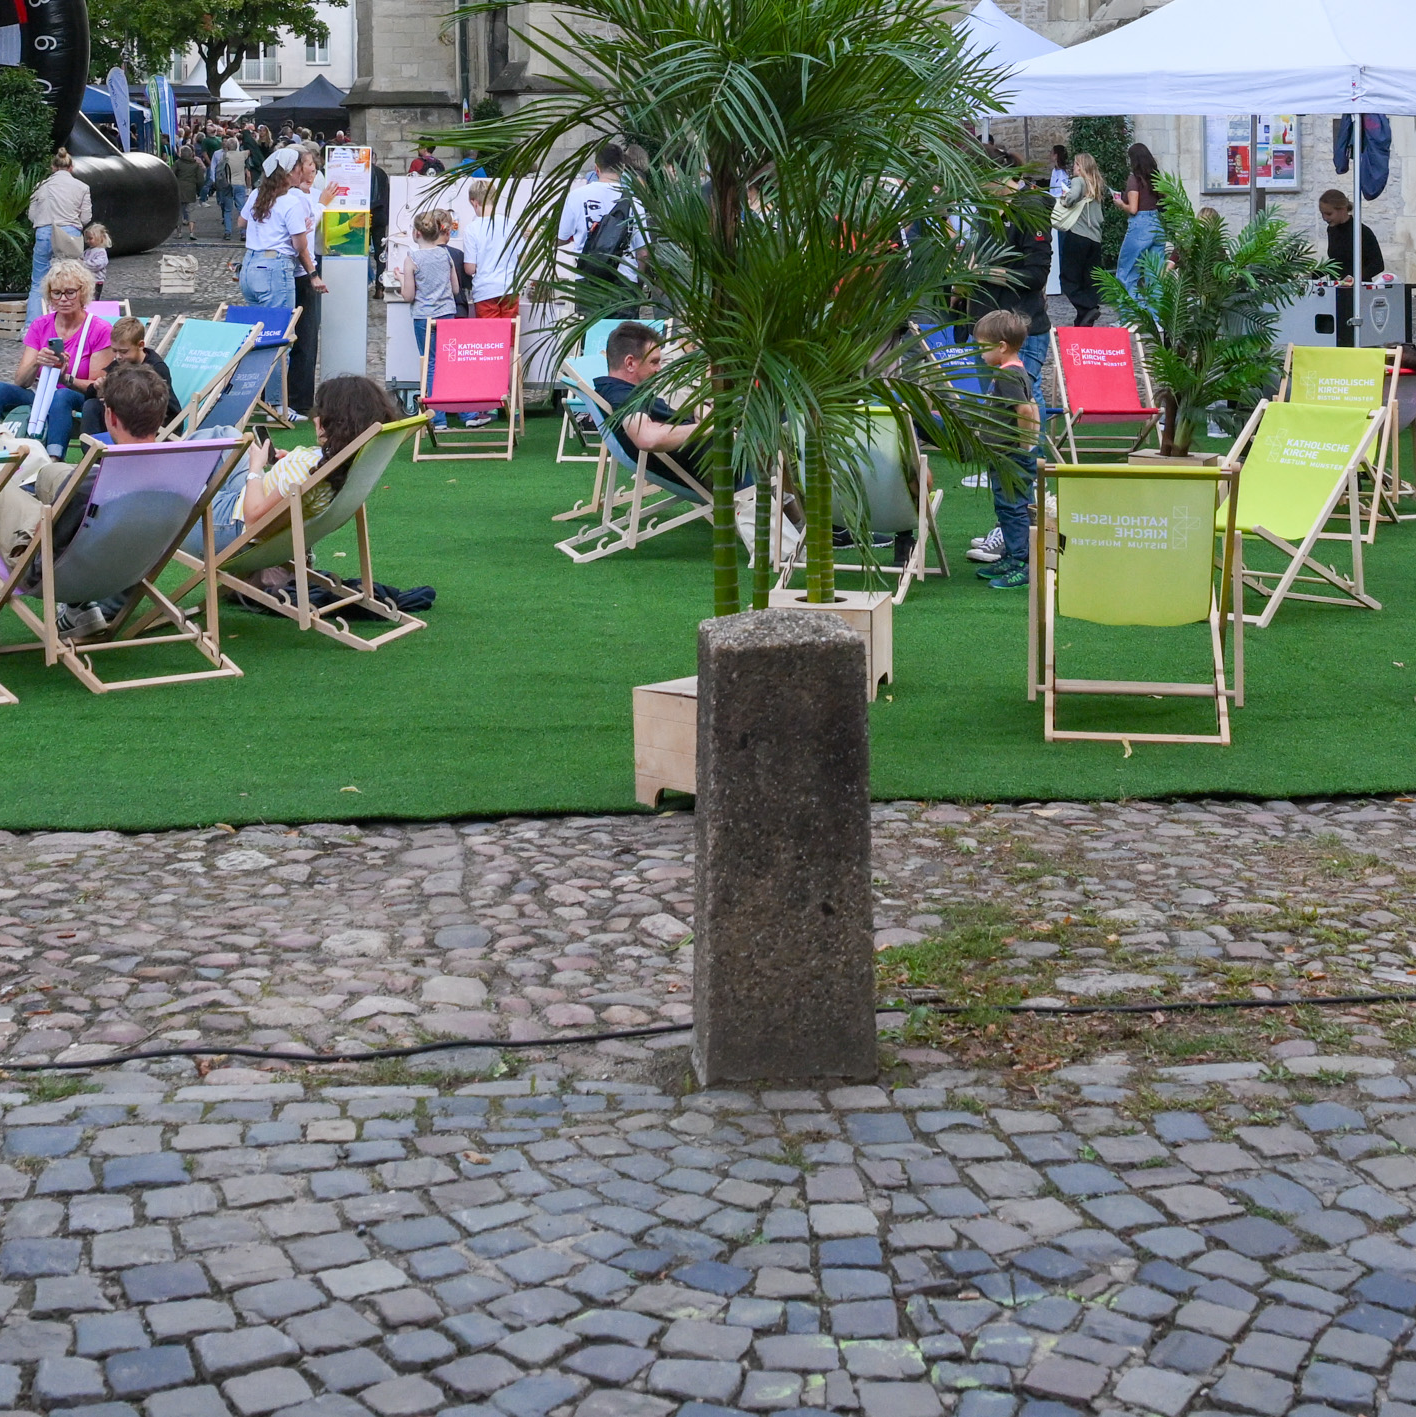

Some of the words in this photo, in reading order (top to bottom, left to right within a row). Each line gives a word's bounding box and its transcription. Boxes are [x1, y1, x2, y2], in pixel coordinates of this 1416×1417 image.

[34, 35, 57, 51] 6
[188, 349, 231, 358] KATHOLISCHE
[1081, 348, 1125, 356] KATHOLISCHE
[184, 355, 209, 364] KIRCHE
[1318, 378, 1375, 386] KATHOLISCHE
[1318, 386, 1348, 394] KIRCHE
[1286, 438, 1350, 453] KATHOLISCHE
[1282, 448, 1319, 460] KIRCHE
[1280, 457, 1306, 466] BISTUM
